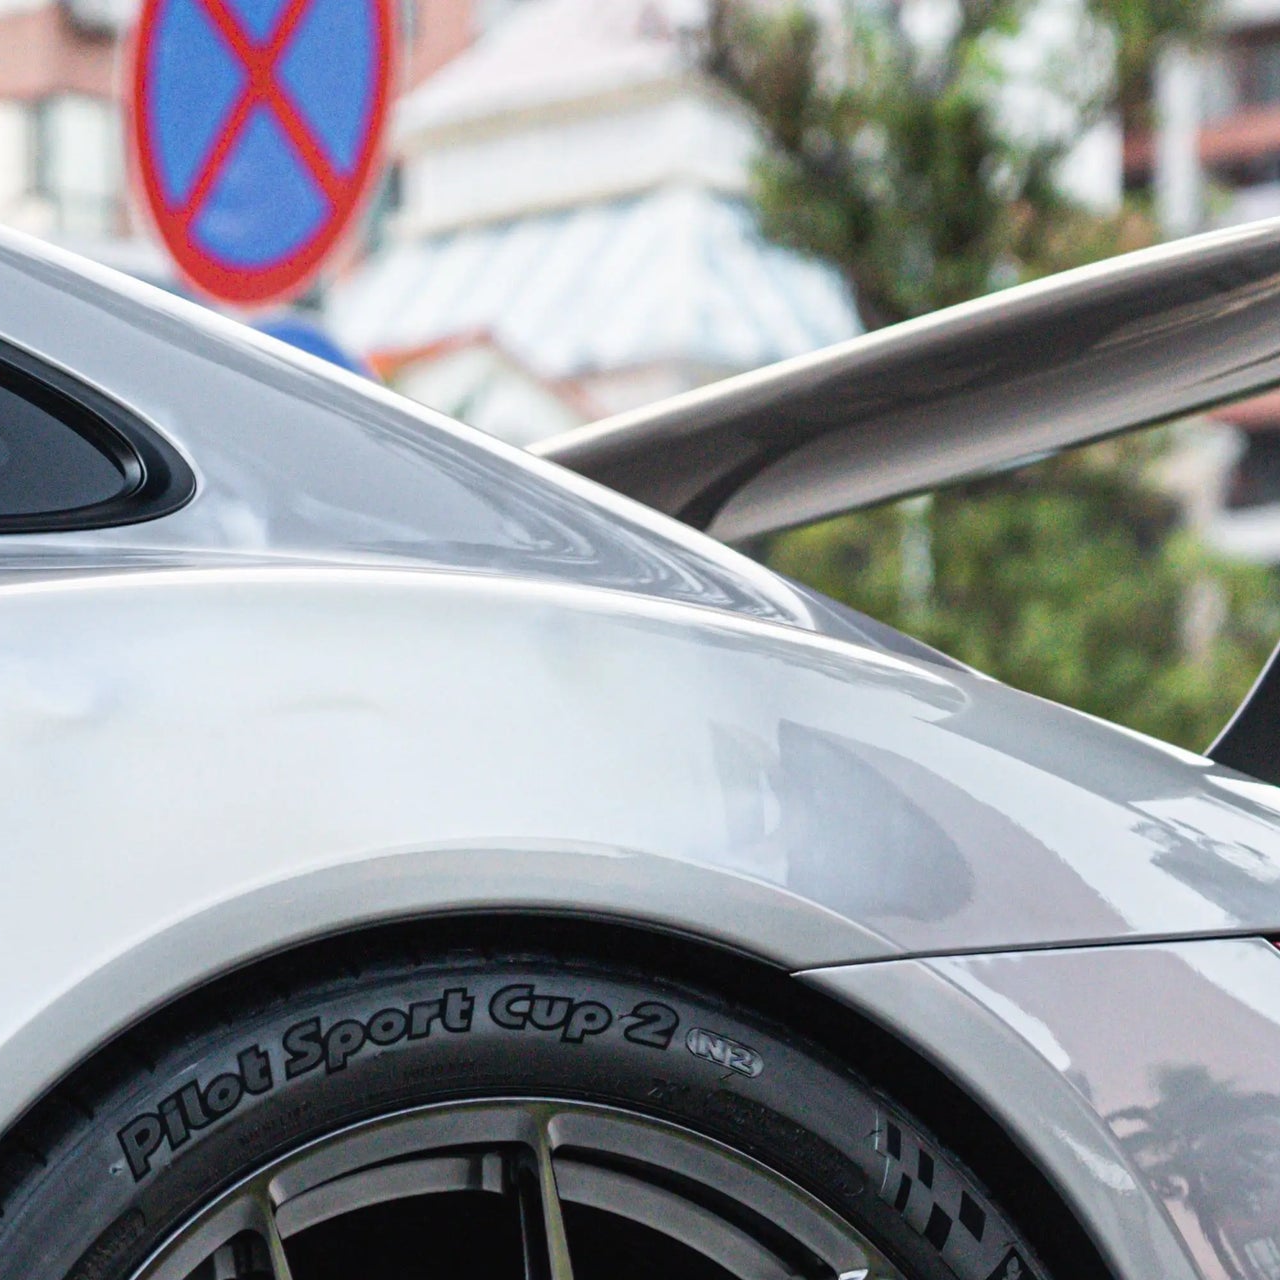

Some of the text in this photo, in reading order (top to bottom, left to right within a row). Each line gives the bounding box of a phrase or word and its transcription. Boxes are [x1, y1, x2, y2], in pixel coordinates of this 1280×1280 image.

[117, 1043, 274, 1183] Pilot
[282, 988, 475, 1079] Sport
[489, 984, 613, 1043] Cup
[623, 1001, 680, 1050] 2
[692, 1030, 758, 1075] N2
